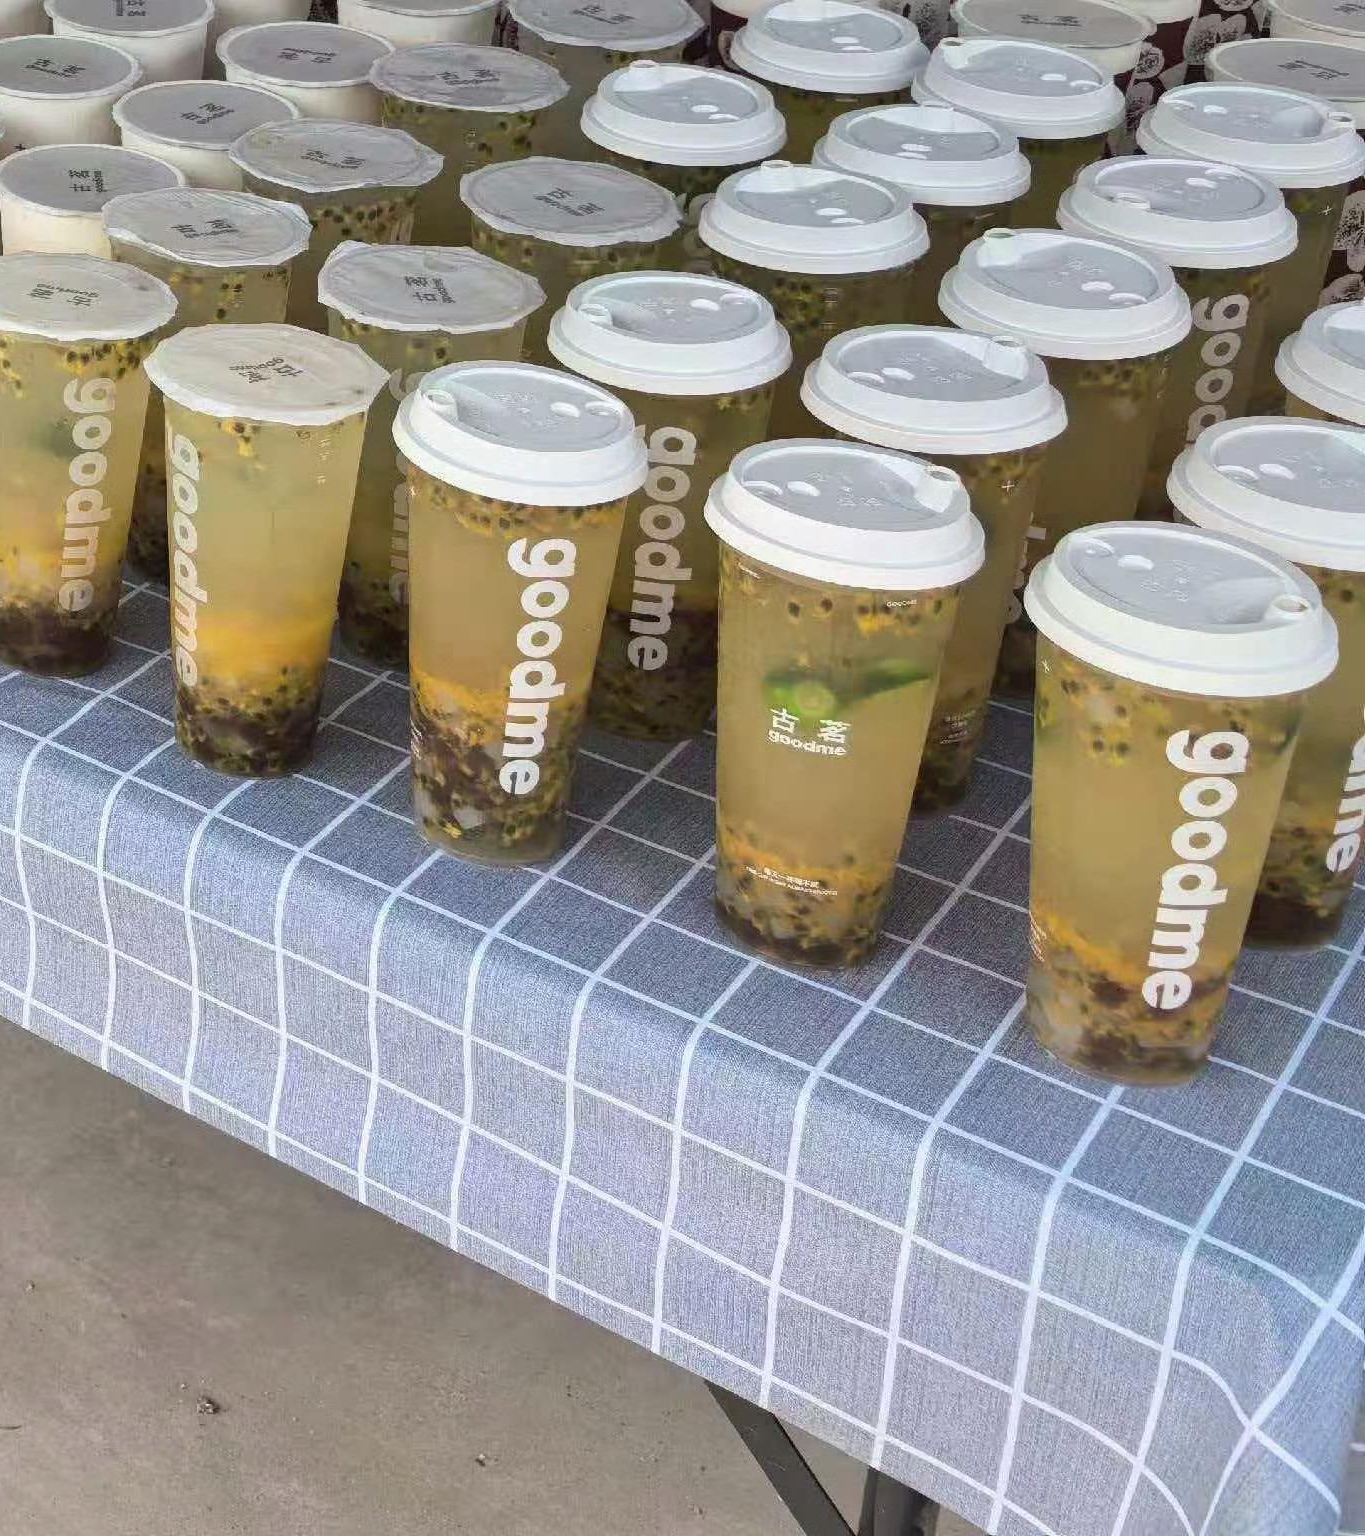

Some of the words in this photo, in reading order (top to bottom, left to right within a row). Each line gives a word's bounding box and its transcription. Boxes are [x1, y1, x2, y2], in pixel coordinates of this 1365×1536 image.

[1193, 294, 1250, 444] good
[59, 377, 116, 612] goodme
[166, 421, 208, 687] goodme
[627, 425, 697, 671] goodme
[499, 538, 577, 795] goodme
[768, 729, 847, 756] goodme
[770, 708, 851, 744] 古茗
[1142, 730, 1250, 1010] goodme
